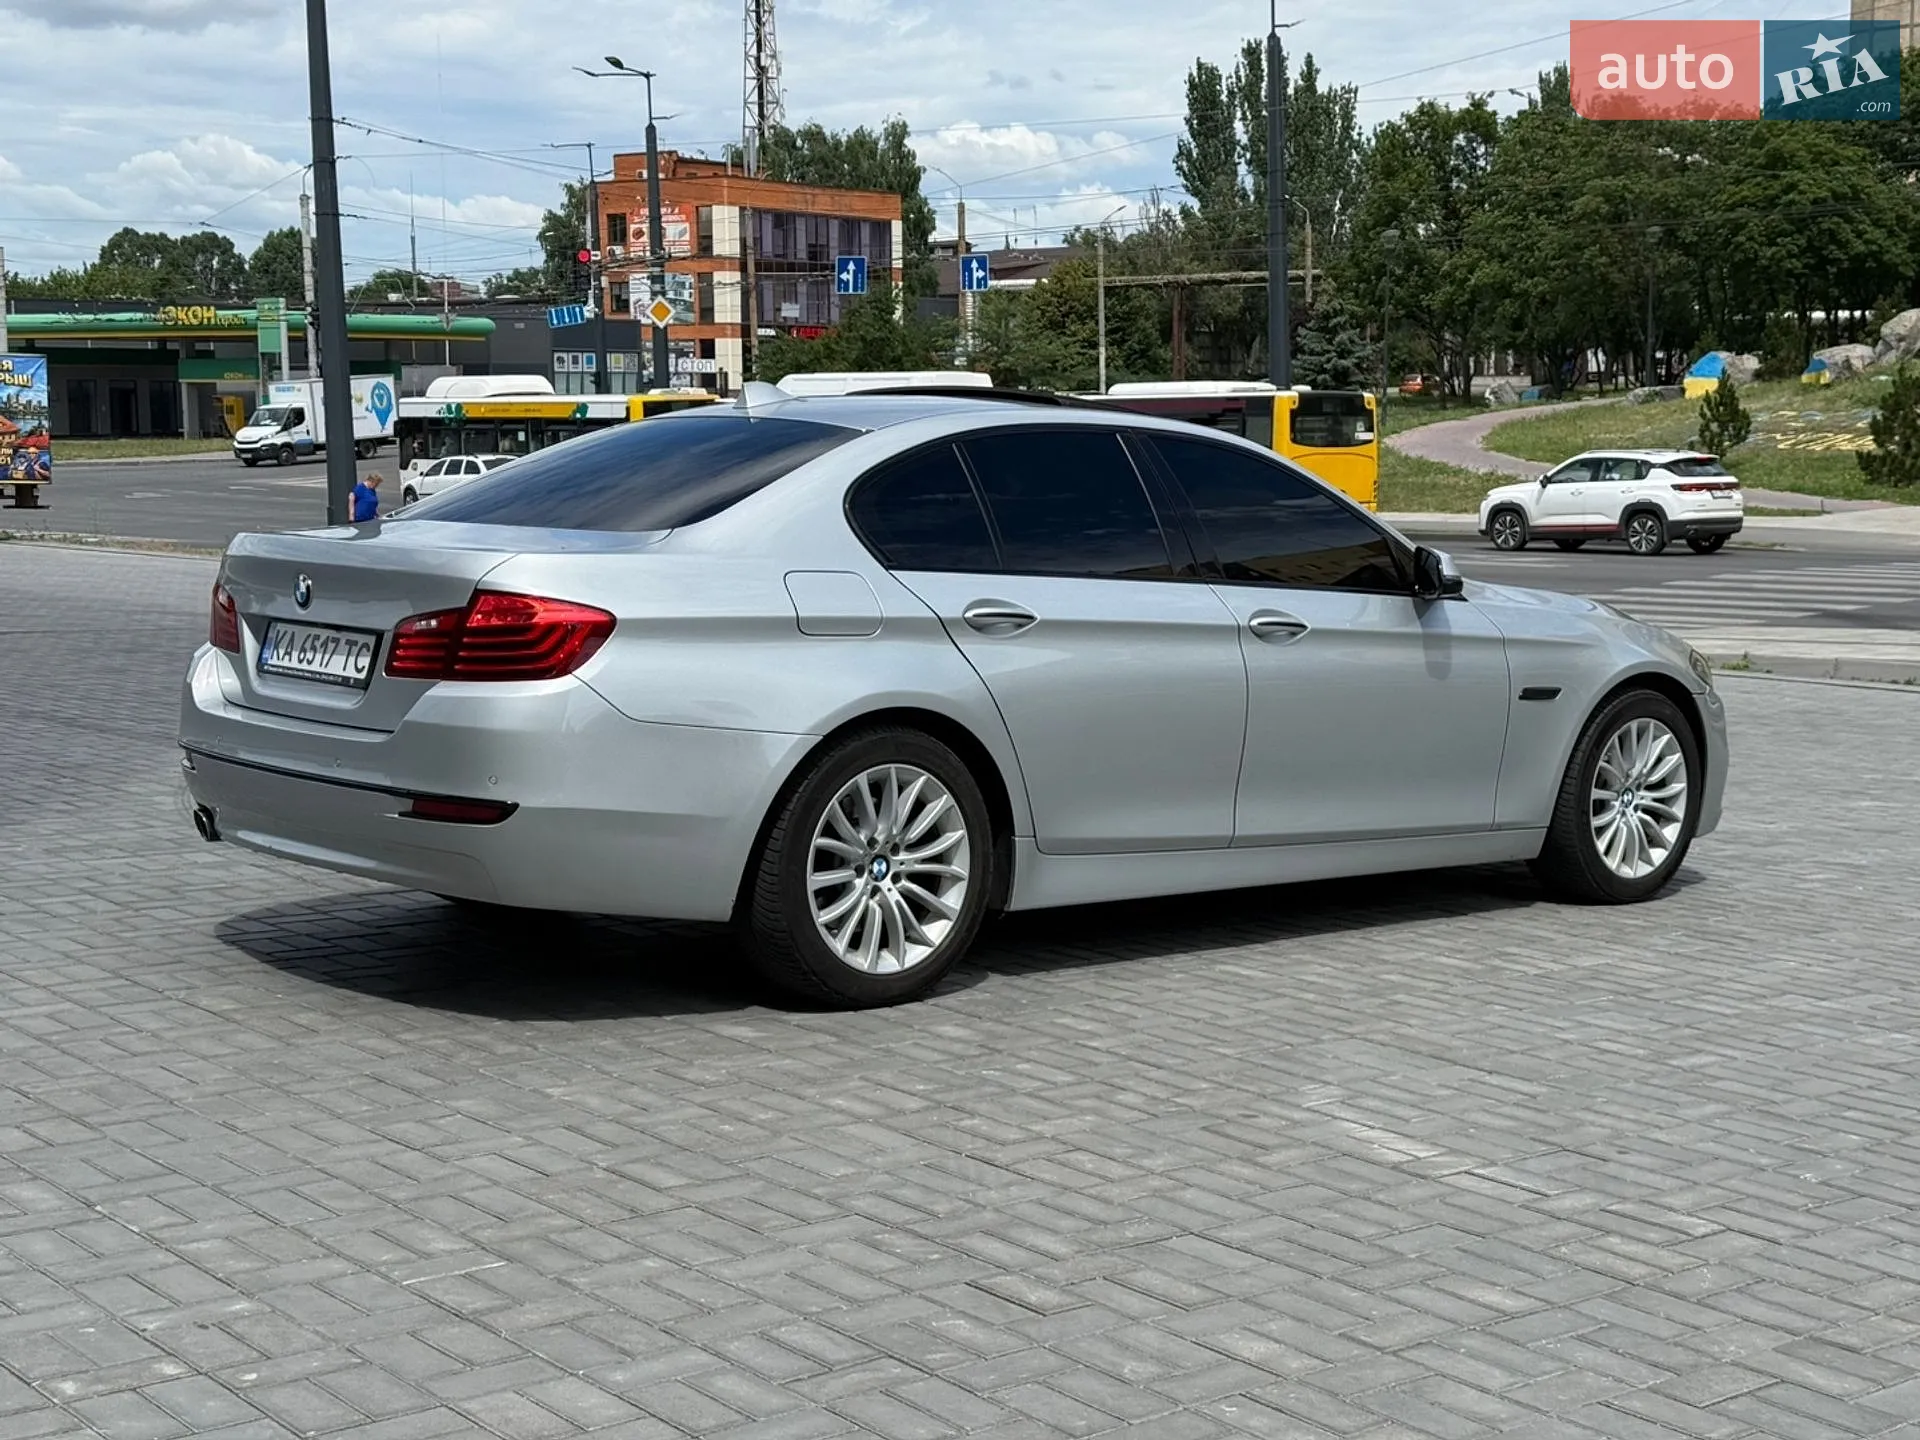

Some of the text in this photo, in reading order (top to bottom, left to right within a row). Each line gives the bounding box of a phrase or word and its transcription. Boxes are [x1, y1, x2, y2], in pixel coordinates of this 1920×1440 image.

[270, 629, 296, 662] KA
[297, 632, 341, 669] 6517
[342, 638, 371, 675] TC
